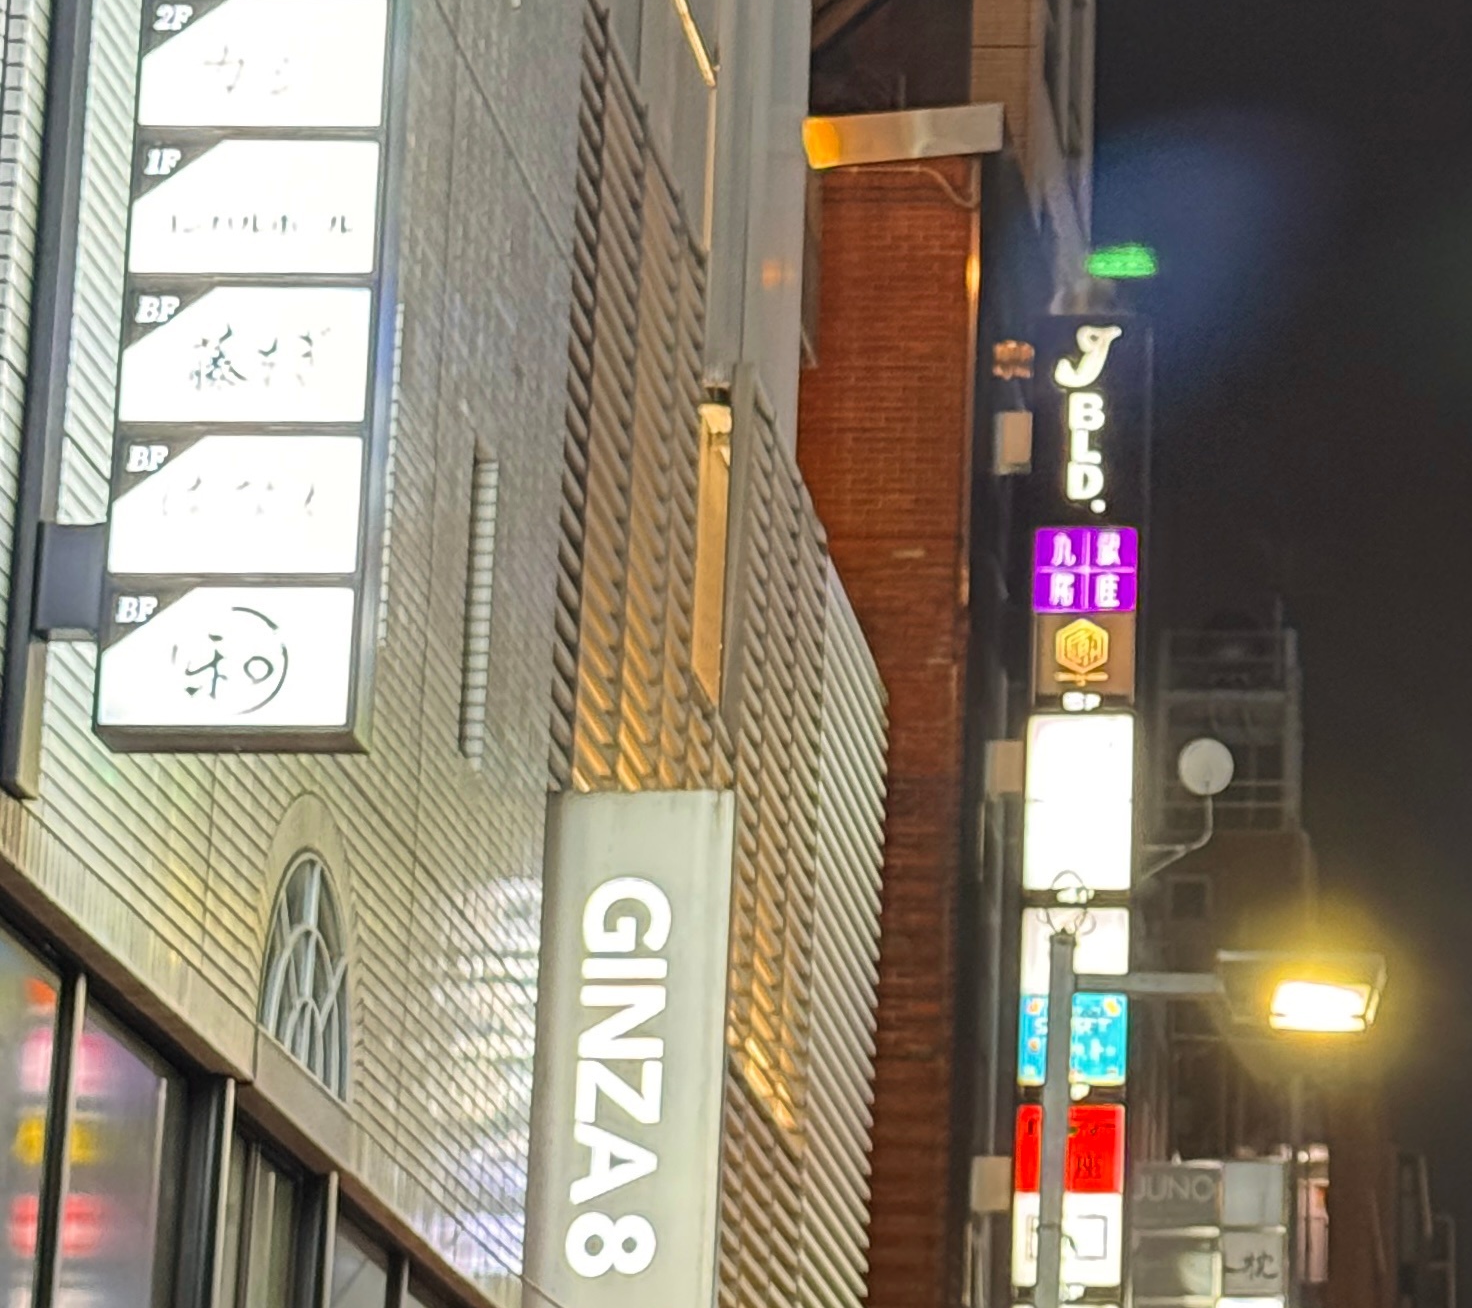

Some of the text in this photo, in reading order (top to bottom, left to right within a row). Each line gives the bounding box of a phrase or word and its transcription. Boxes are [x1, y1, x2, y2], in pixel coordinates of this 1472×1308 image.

[154, 4, 192, 30] 2F
[145, 149, 181, 176] 1F
[137, 297, 179, 323] BF
[127, 447, 168, 471] BF
[118, 598, 158, 623] BF
